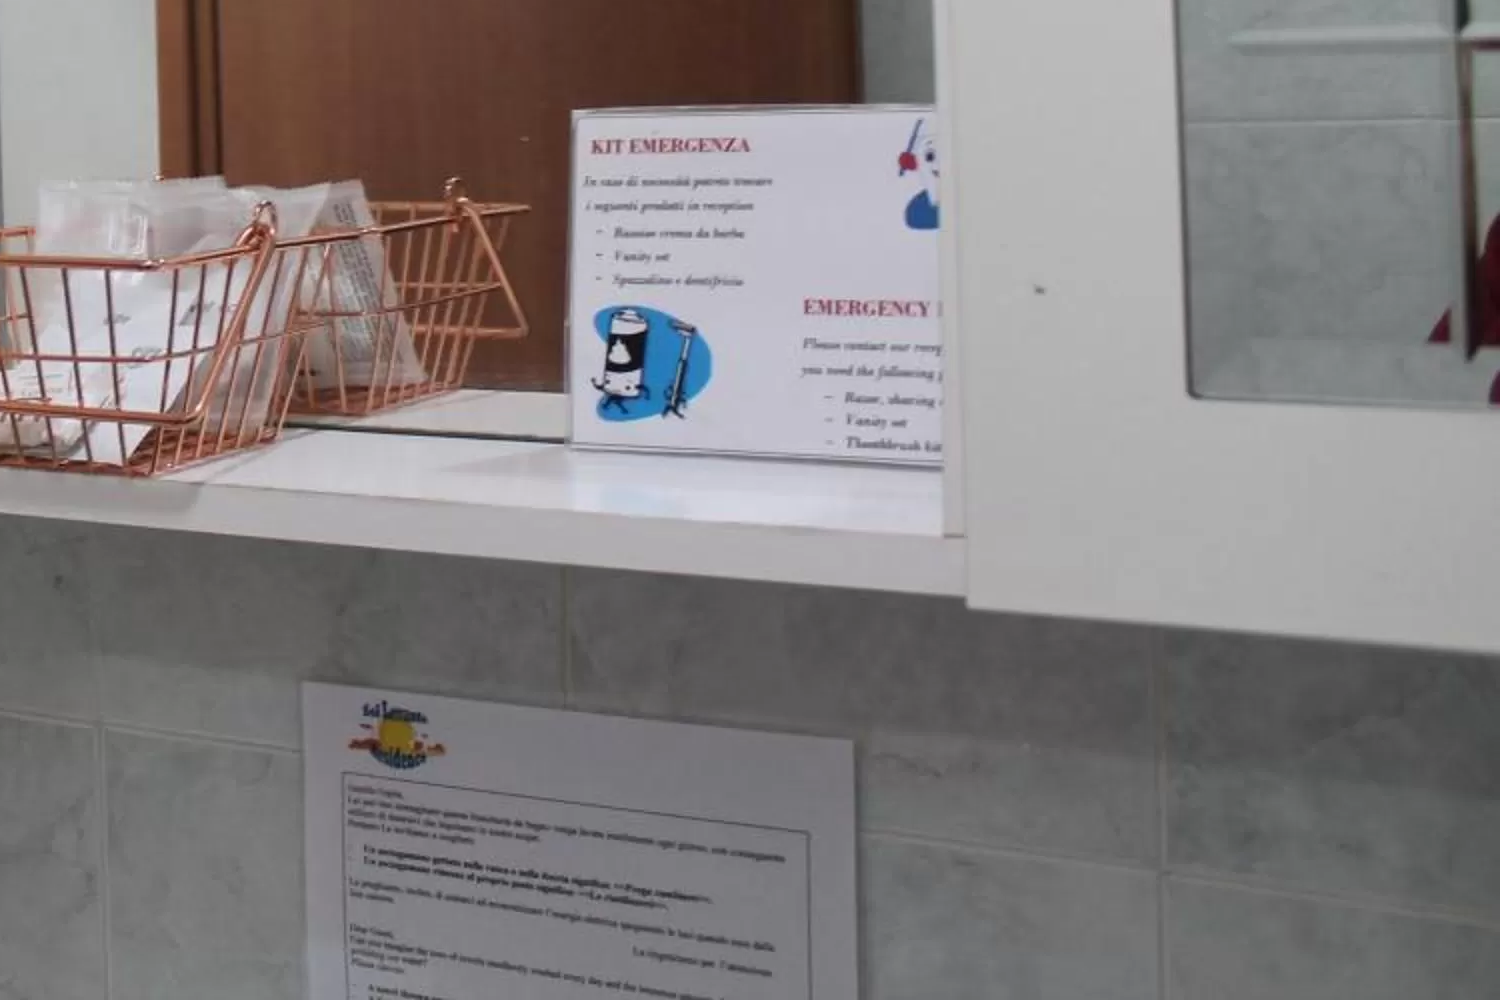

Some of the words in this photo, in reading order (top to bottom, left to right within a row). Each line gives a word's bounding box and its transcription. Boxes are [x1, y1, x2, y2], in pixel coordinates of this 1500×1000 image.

[590, 138, 624, 155] KIT
[628, 137, 751, 155] EMERGENZA
[803, 298, 931, 318] EMERGENCY
[856, 364, 875, 377] the
